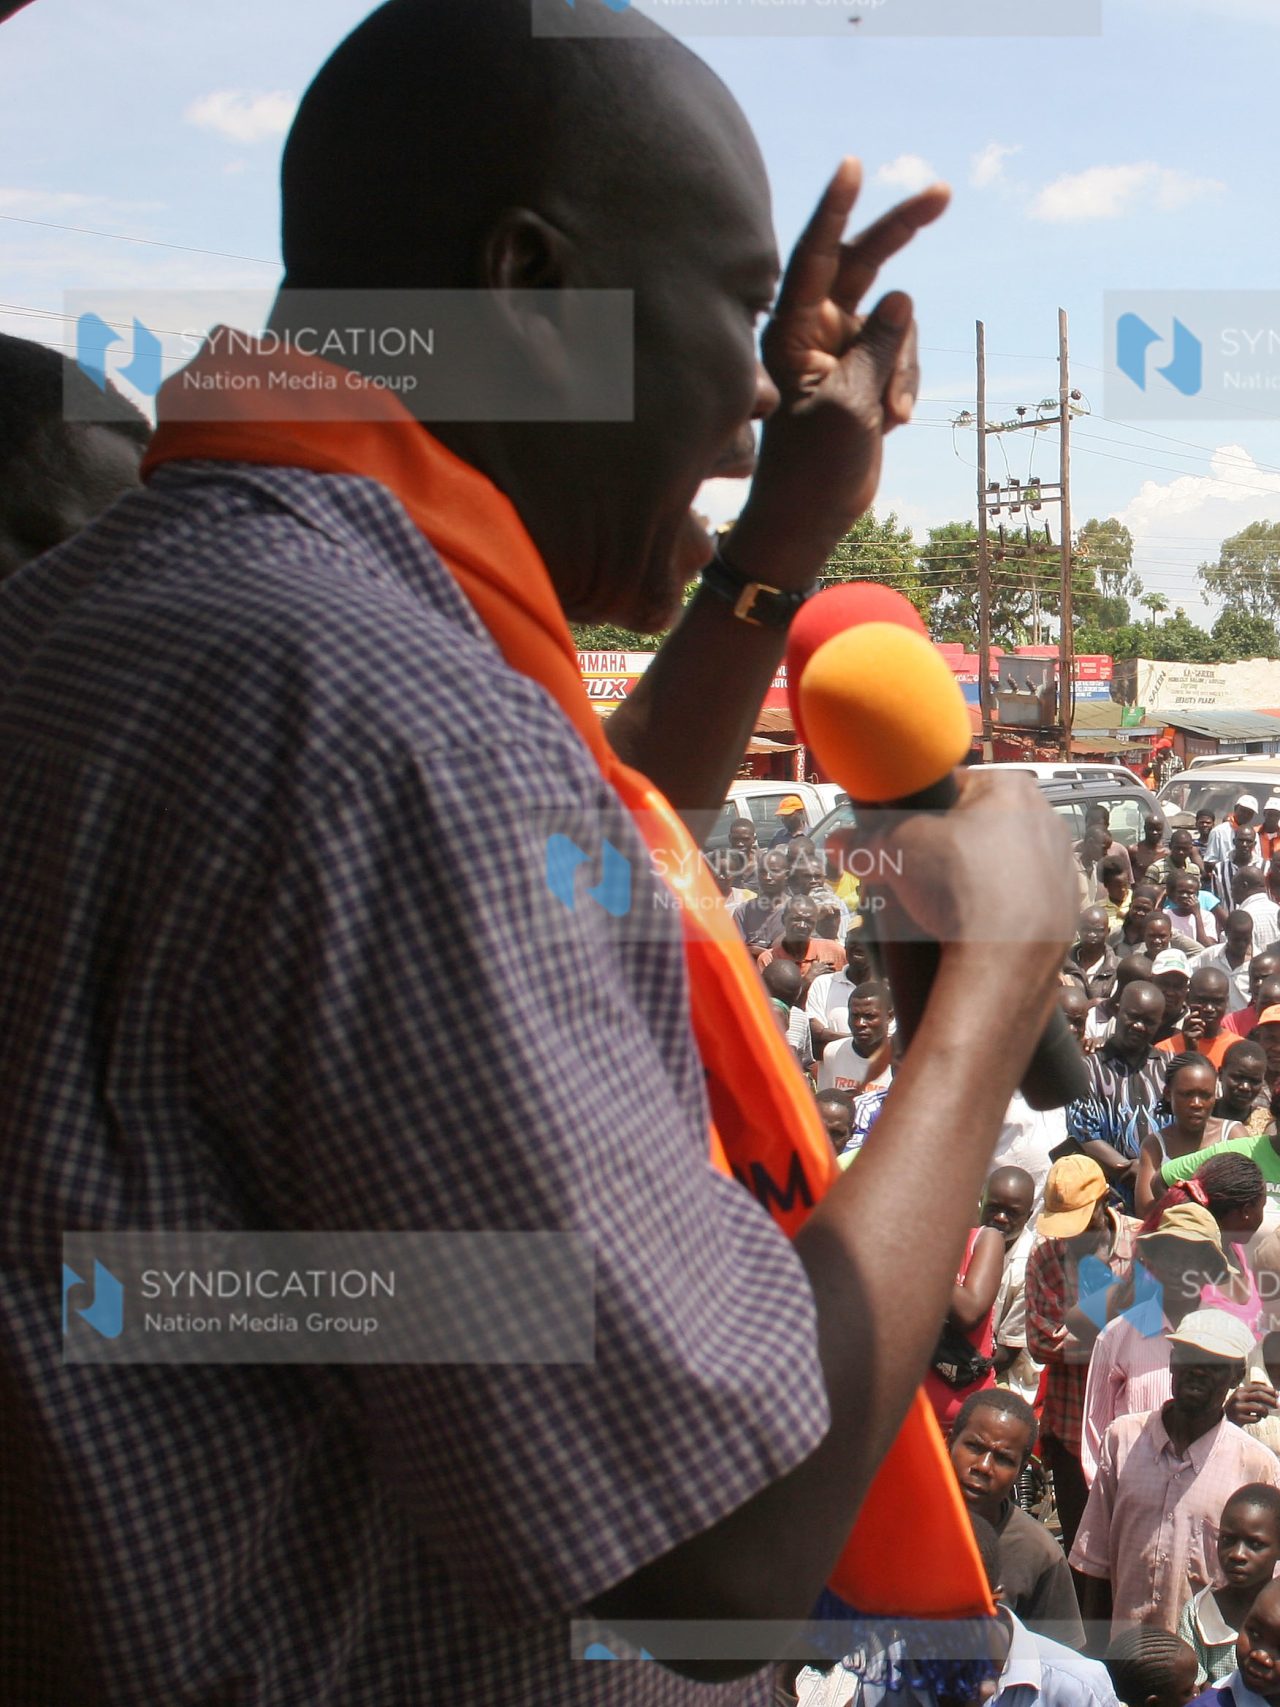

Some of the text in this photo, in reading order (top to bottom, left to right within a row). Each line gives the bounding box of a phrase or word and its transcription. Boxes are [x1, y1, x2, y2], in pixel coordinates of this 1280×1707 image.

[577, 654, 627, 672] AMAHA
[583, 678, 627, 699] UX
[731, 1150, 814, 1212] M
